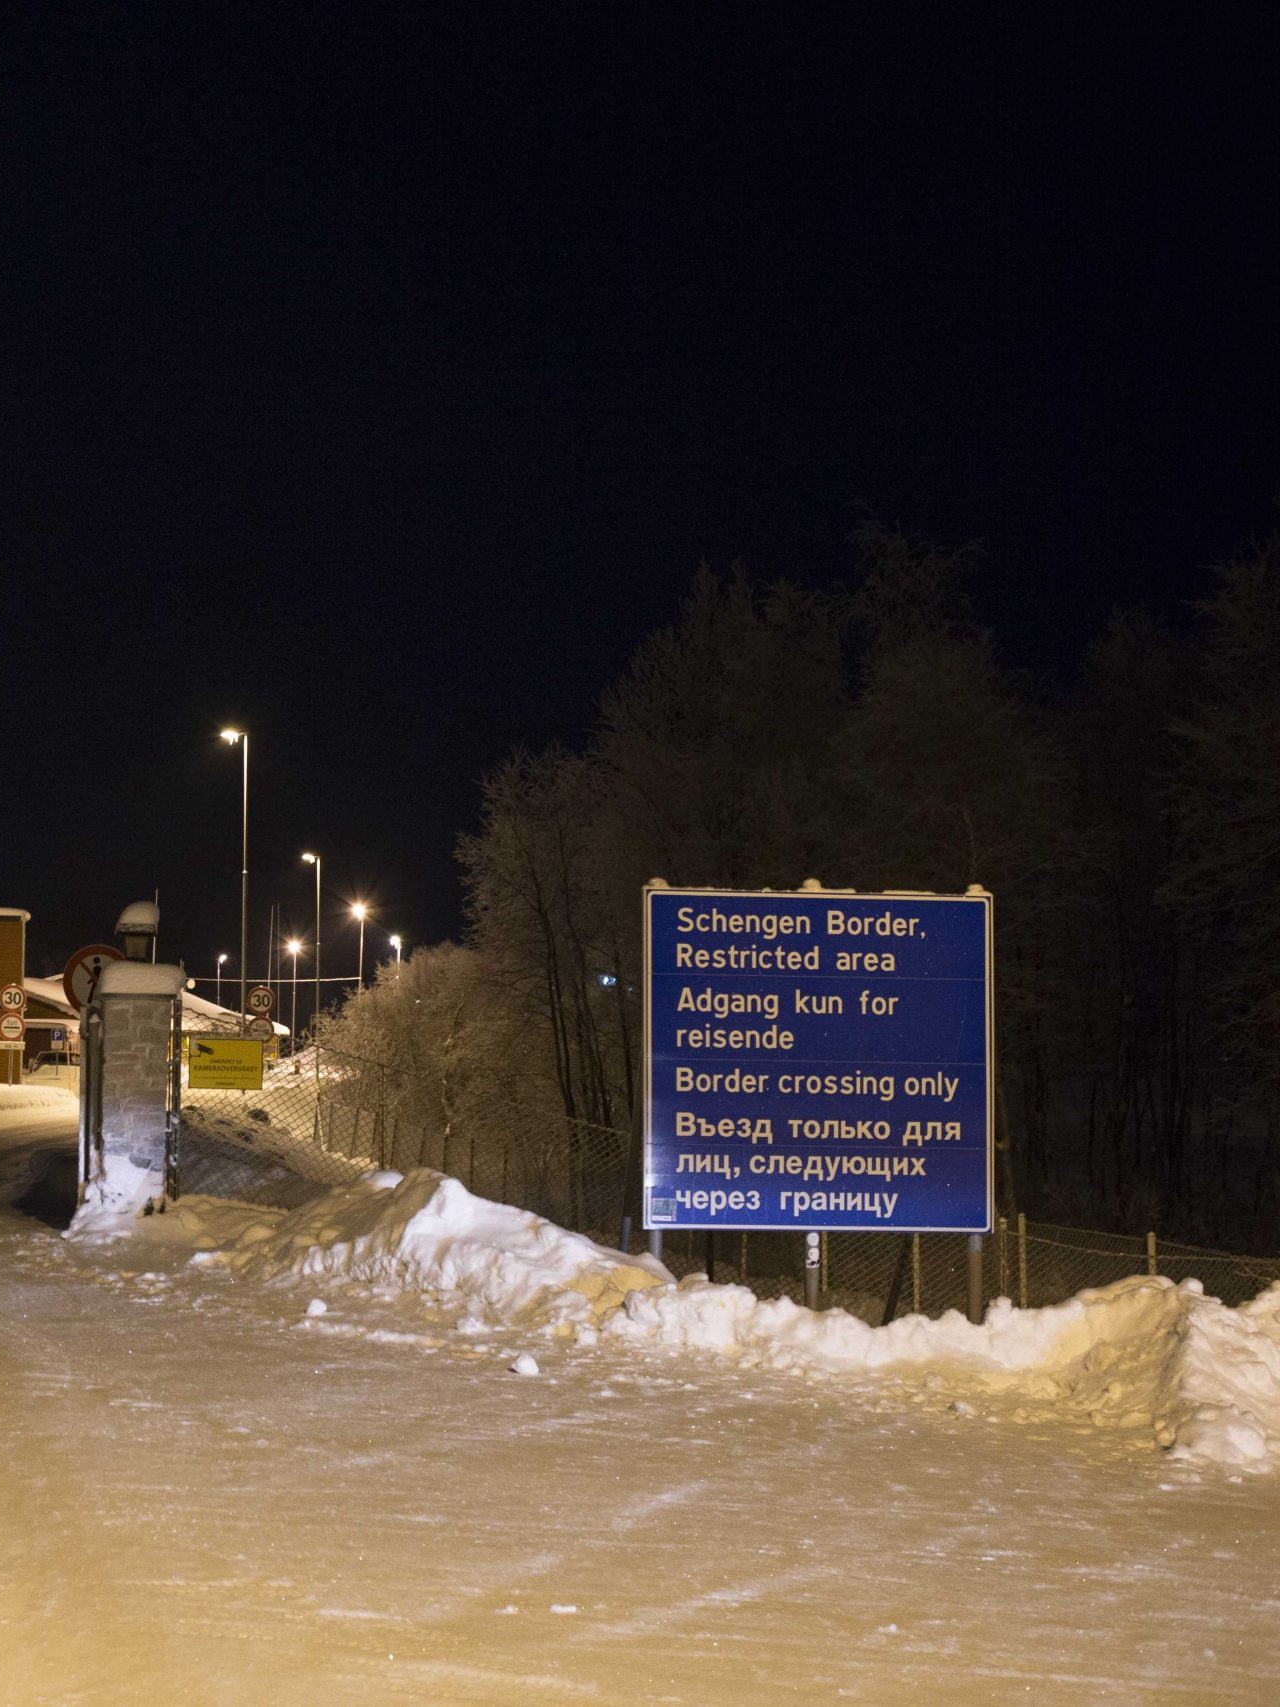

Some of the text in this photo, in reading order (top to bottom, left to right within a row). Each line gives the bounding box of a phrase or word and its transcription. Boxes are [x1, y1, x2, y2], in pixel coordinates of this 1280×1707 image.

[677, 907, 926, 940] Schengen Border,
[676, 943, 895, 972] Restricted area
[4, 991, 21, 1005] 30
[253, 994, 270, 1008] 30
[677, 987, 899, 1020] Adgang kun for
[676, 1024, 794, 1050] reisende
[676, 1067, 960, 1103] Border crossing only
[676, 1111, 961, 1147] Въезд только для
[675, 1153, 926, 1182] лиц, следующих
[675, 1190, 898, 1219] через границу
